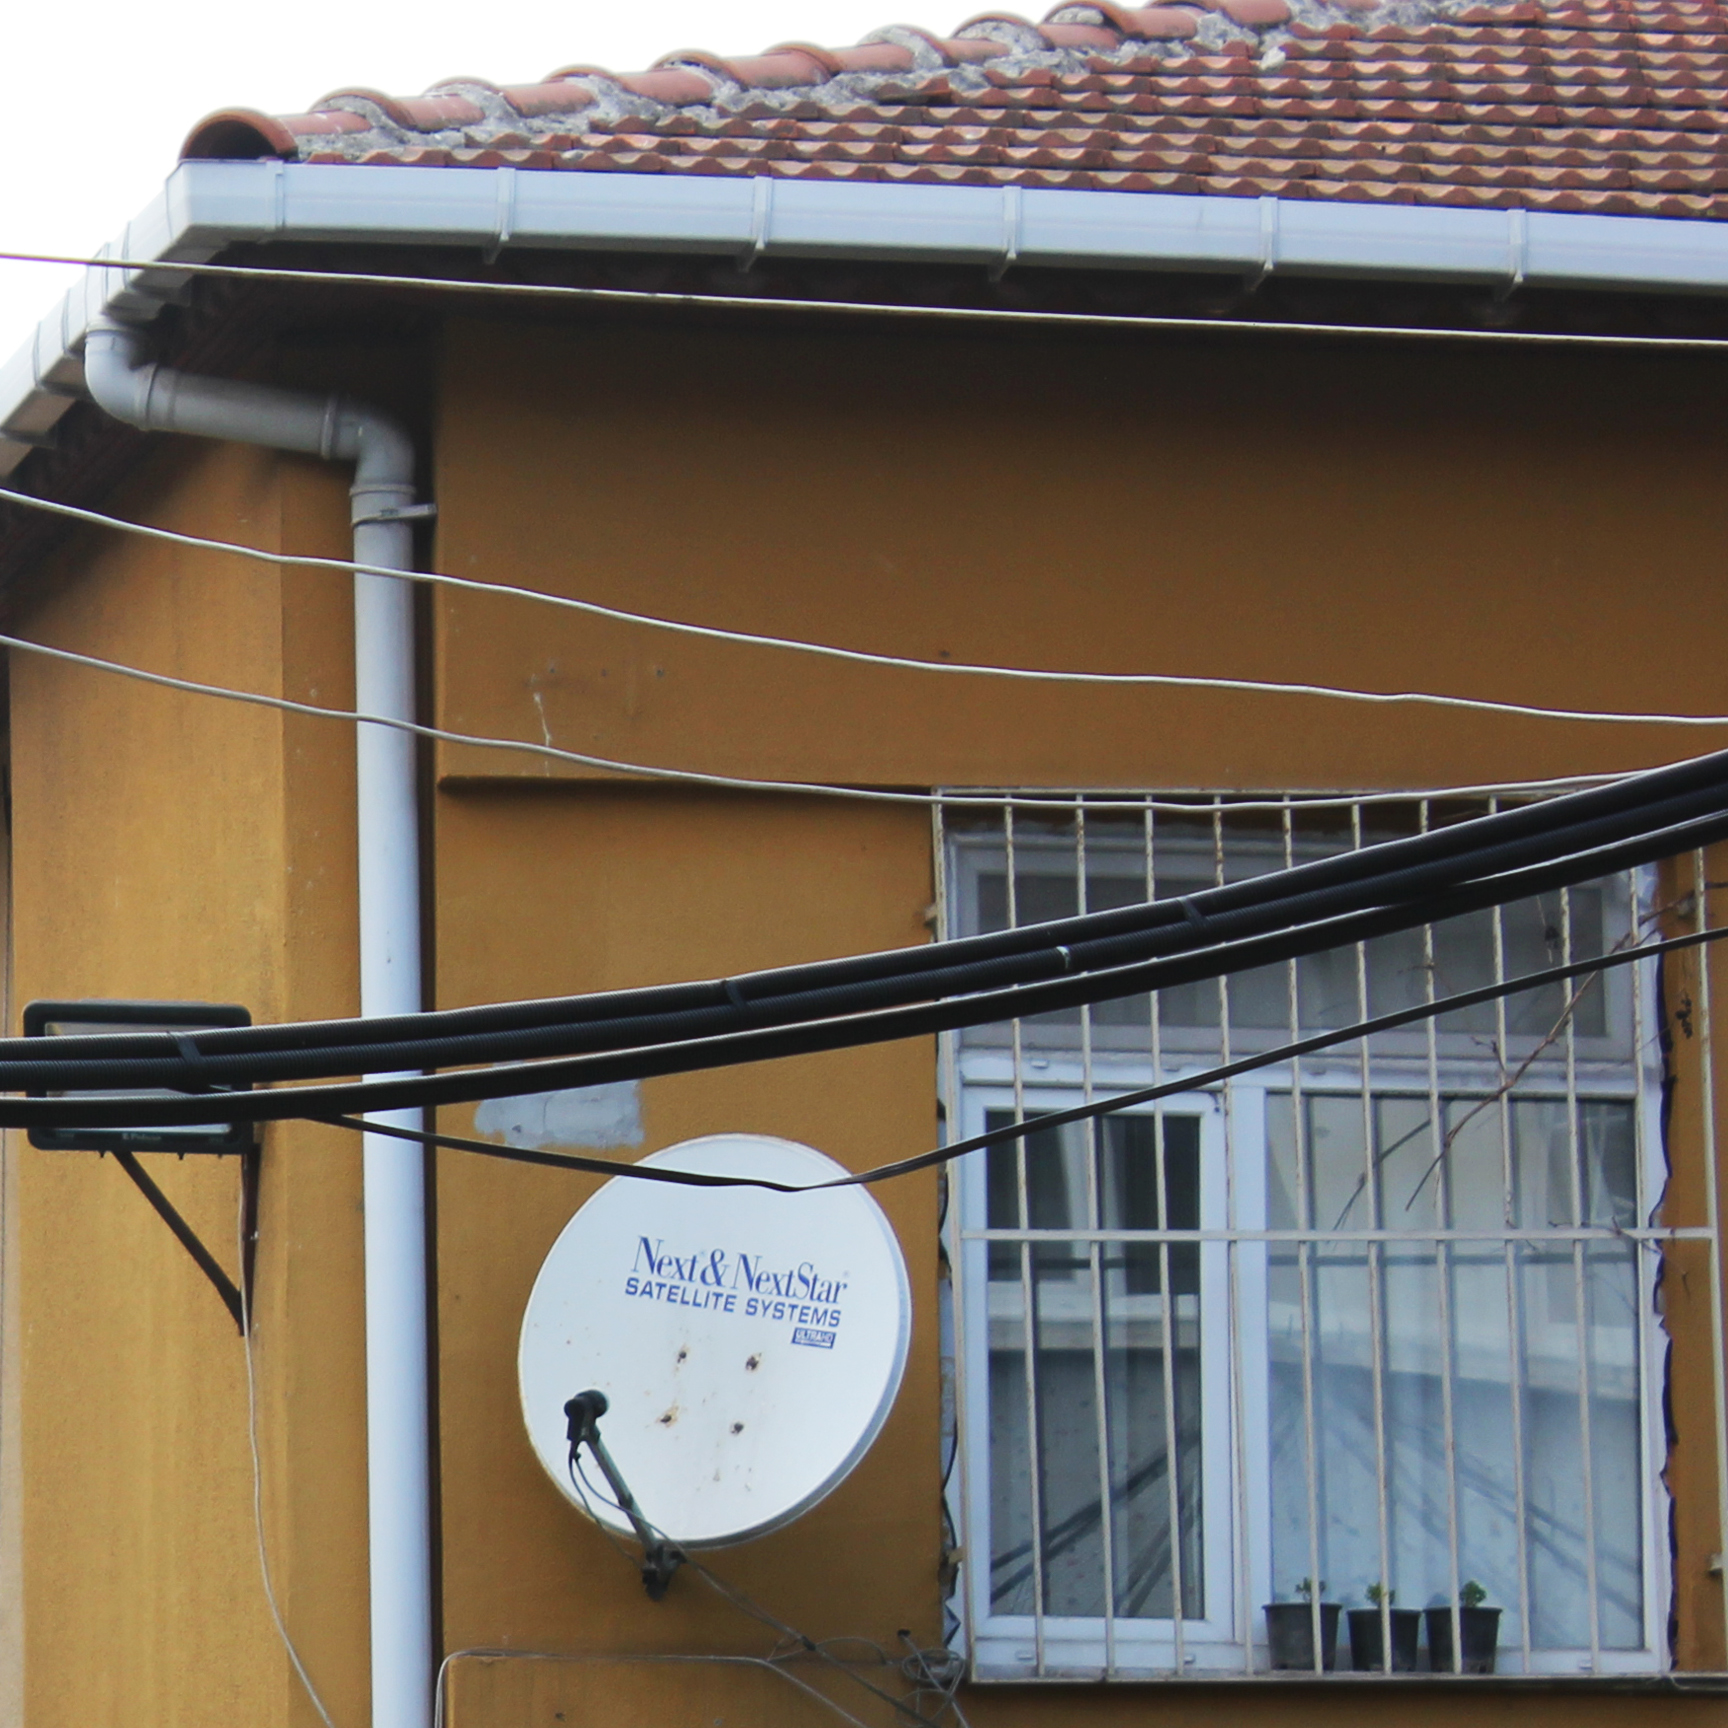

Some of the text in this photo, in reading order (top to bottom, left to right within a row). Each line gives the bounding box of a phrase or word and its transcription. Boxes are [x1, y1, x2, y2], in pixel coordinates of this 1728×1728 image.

[631, 1235, 697, 1283] Next
[732, 1252, 848, 1305] NextStar
[625, 1277, 842, 1328] SATELLITE SYSTEMS
